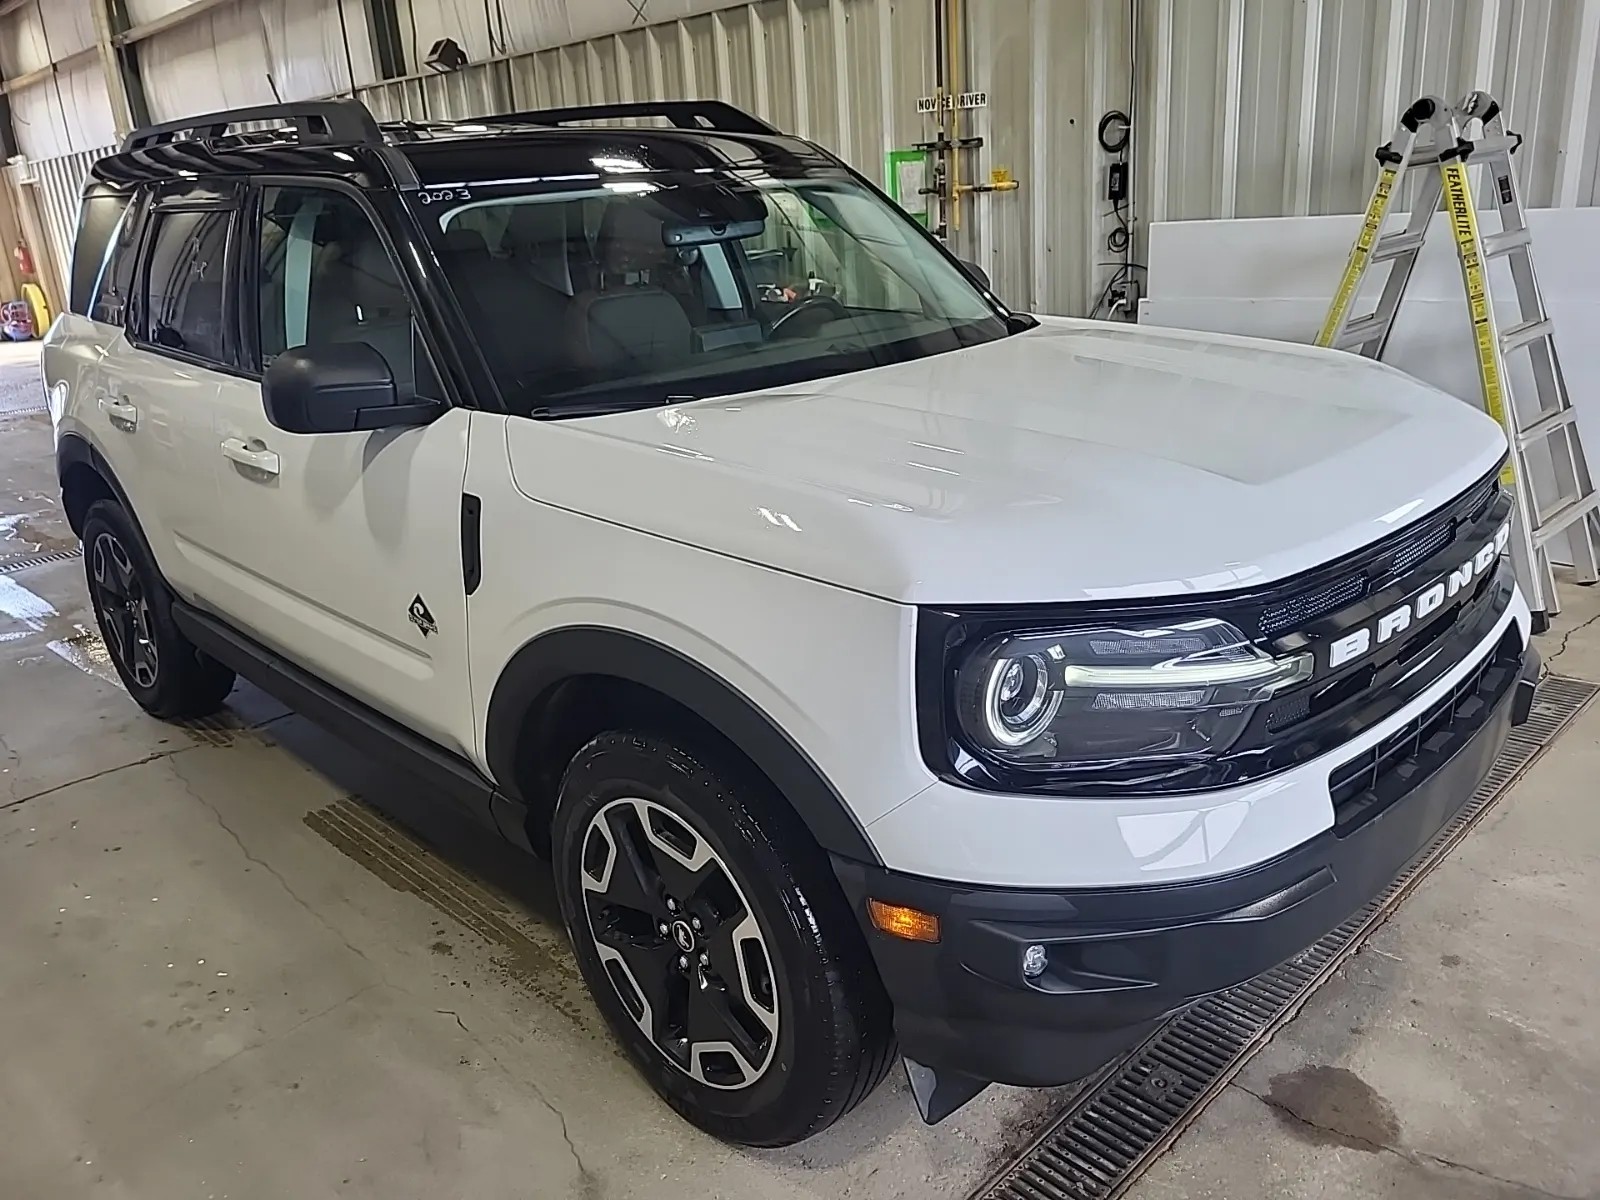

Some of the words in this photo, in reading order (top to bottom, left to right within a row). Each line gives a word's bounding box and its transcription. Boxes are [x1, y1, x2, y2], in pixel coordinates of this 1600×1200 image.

[918, 97, 951, 111] NOVCE
[955, 93, 986, 107] RIVER
[418, 188, 472, 205] 2023
[1446, 167, 1472, 237] FEATHERLITE
[1329, 522, 1510, 668] BRONCO
